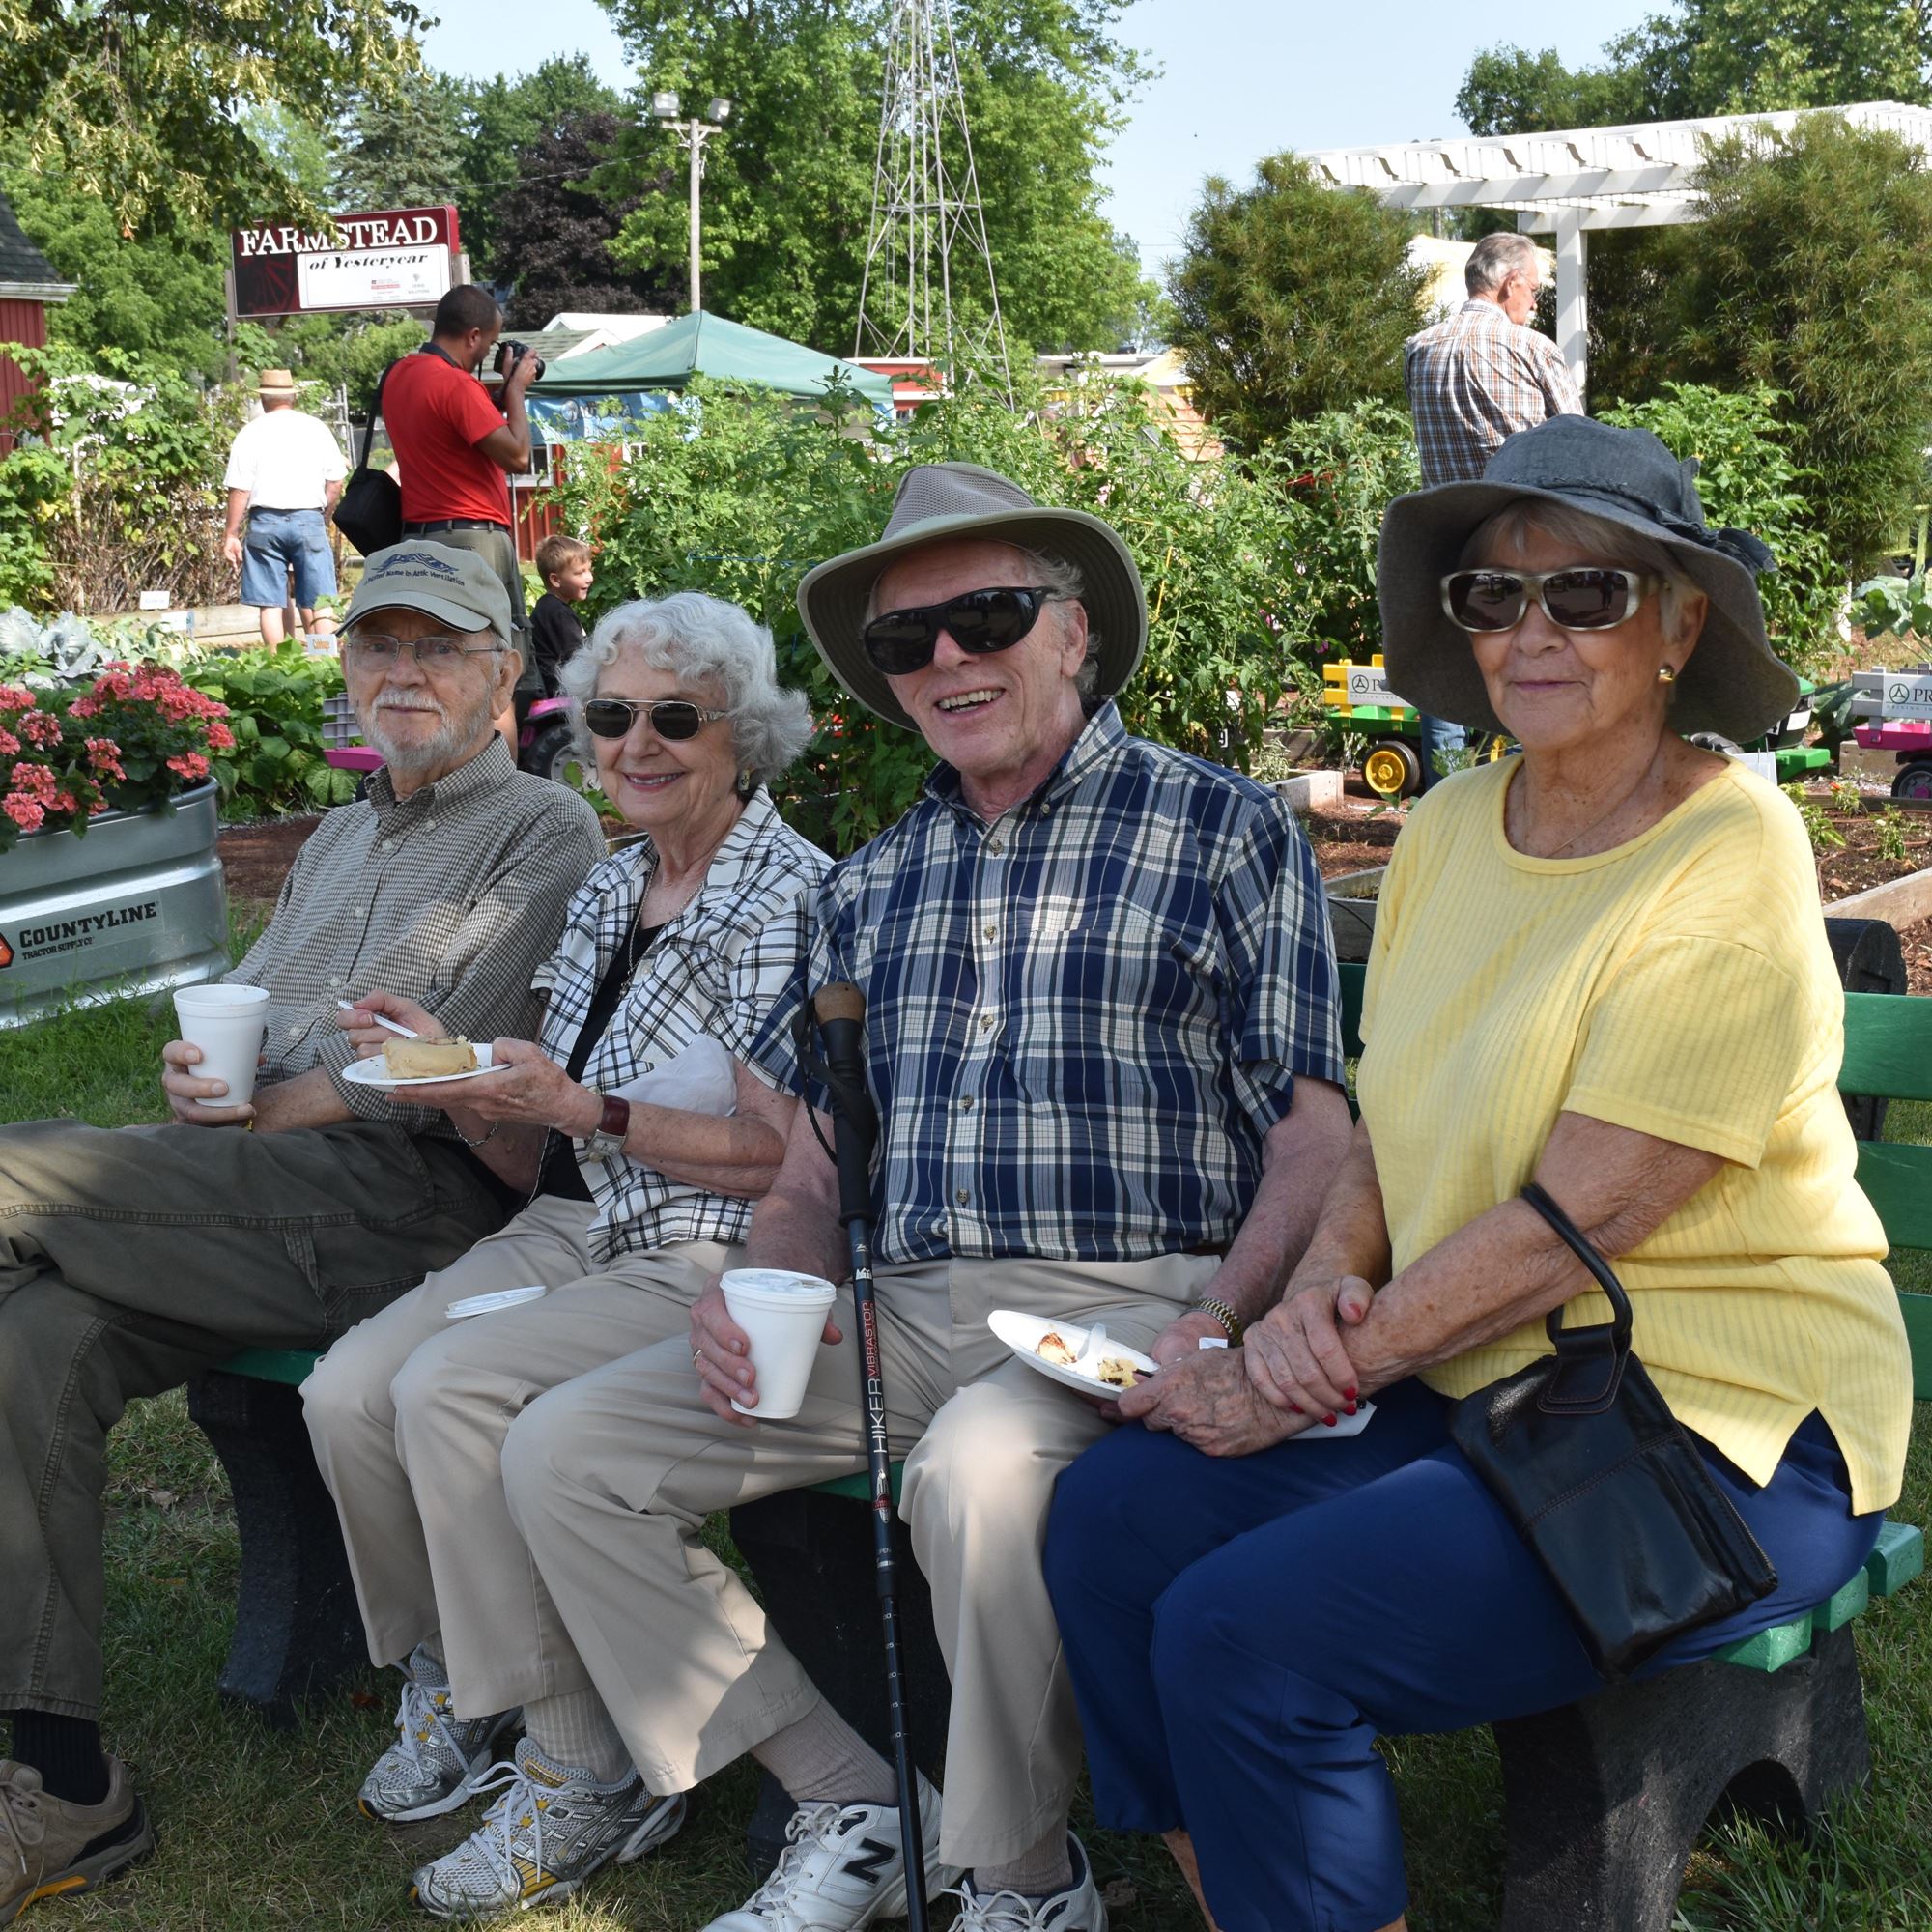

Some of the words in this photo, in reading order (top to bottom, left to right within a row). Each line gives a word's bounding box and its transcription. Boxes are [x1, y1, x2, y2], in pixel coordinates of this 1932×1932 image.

[240, 216, 438, 257] FARMSTEAD
[309, 257, 328, 270] of
[333, 254, 429, 270] Yesteryear
[429, 571, 465, 586] Ventilation
[22, 944, 58, 960] TRACTOR
[58, 938, 84, 952] SUPPLY
[862, 1300, 877, 1377] VIBRASTOP
[867, 1378, 887, 1454] HIKER
